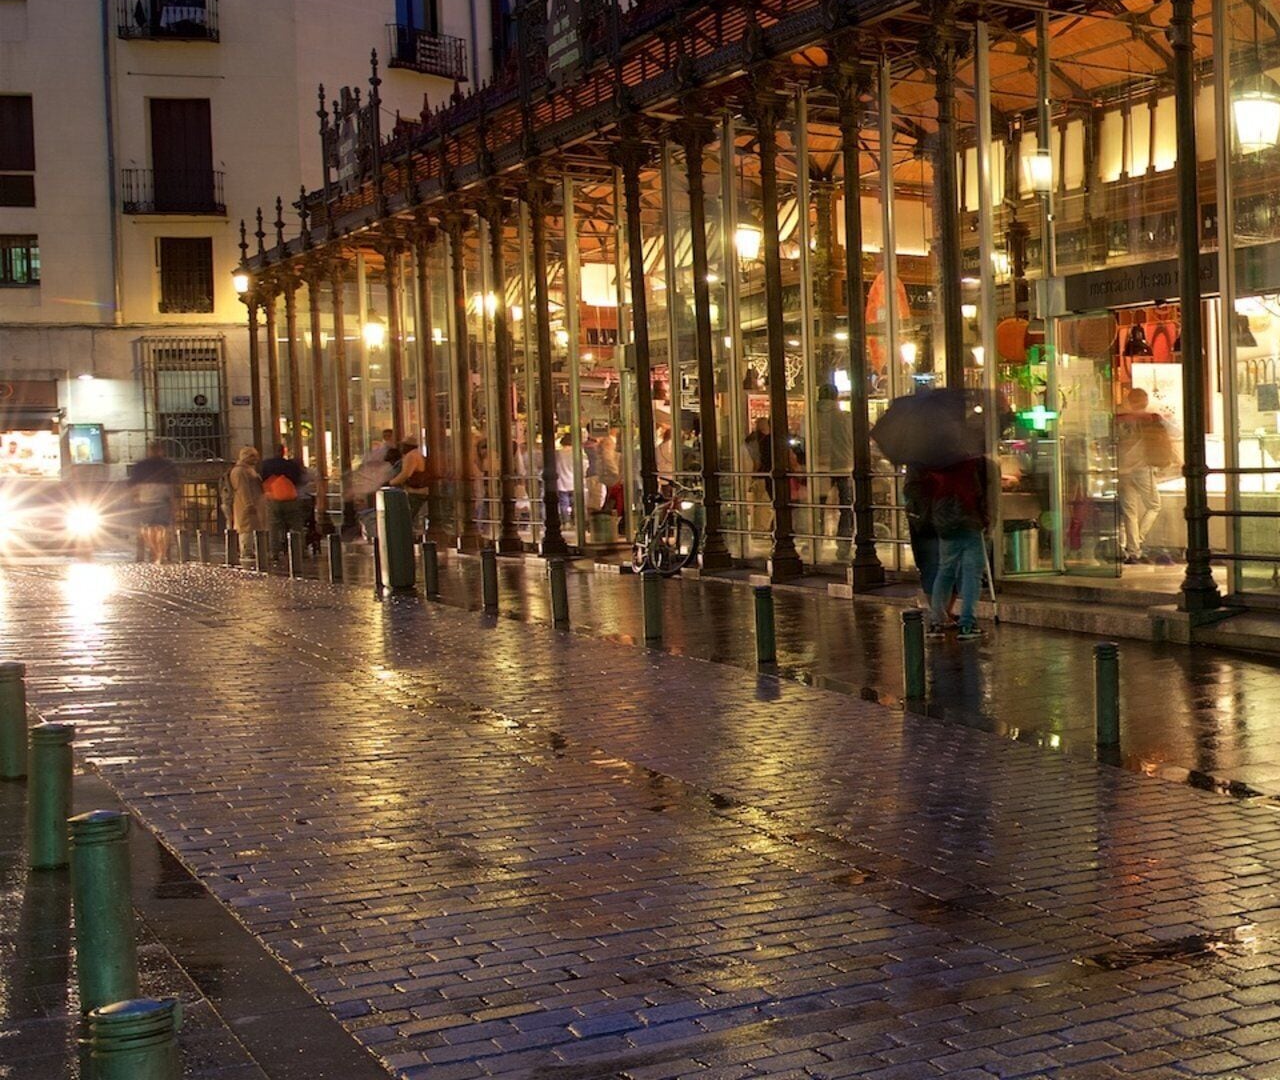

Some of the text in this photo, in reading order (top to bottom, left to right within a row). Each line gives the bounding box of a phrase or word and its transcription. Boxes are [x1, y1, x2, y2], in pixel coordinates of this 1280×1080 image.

[1090, 272, 1134, 296] mercado
[1136, 269, 1150, 289] de
[167, 416, 214, 429] pizzas
